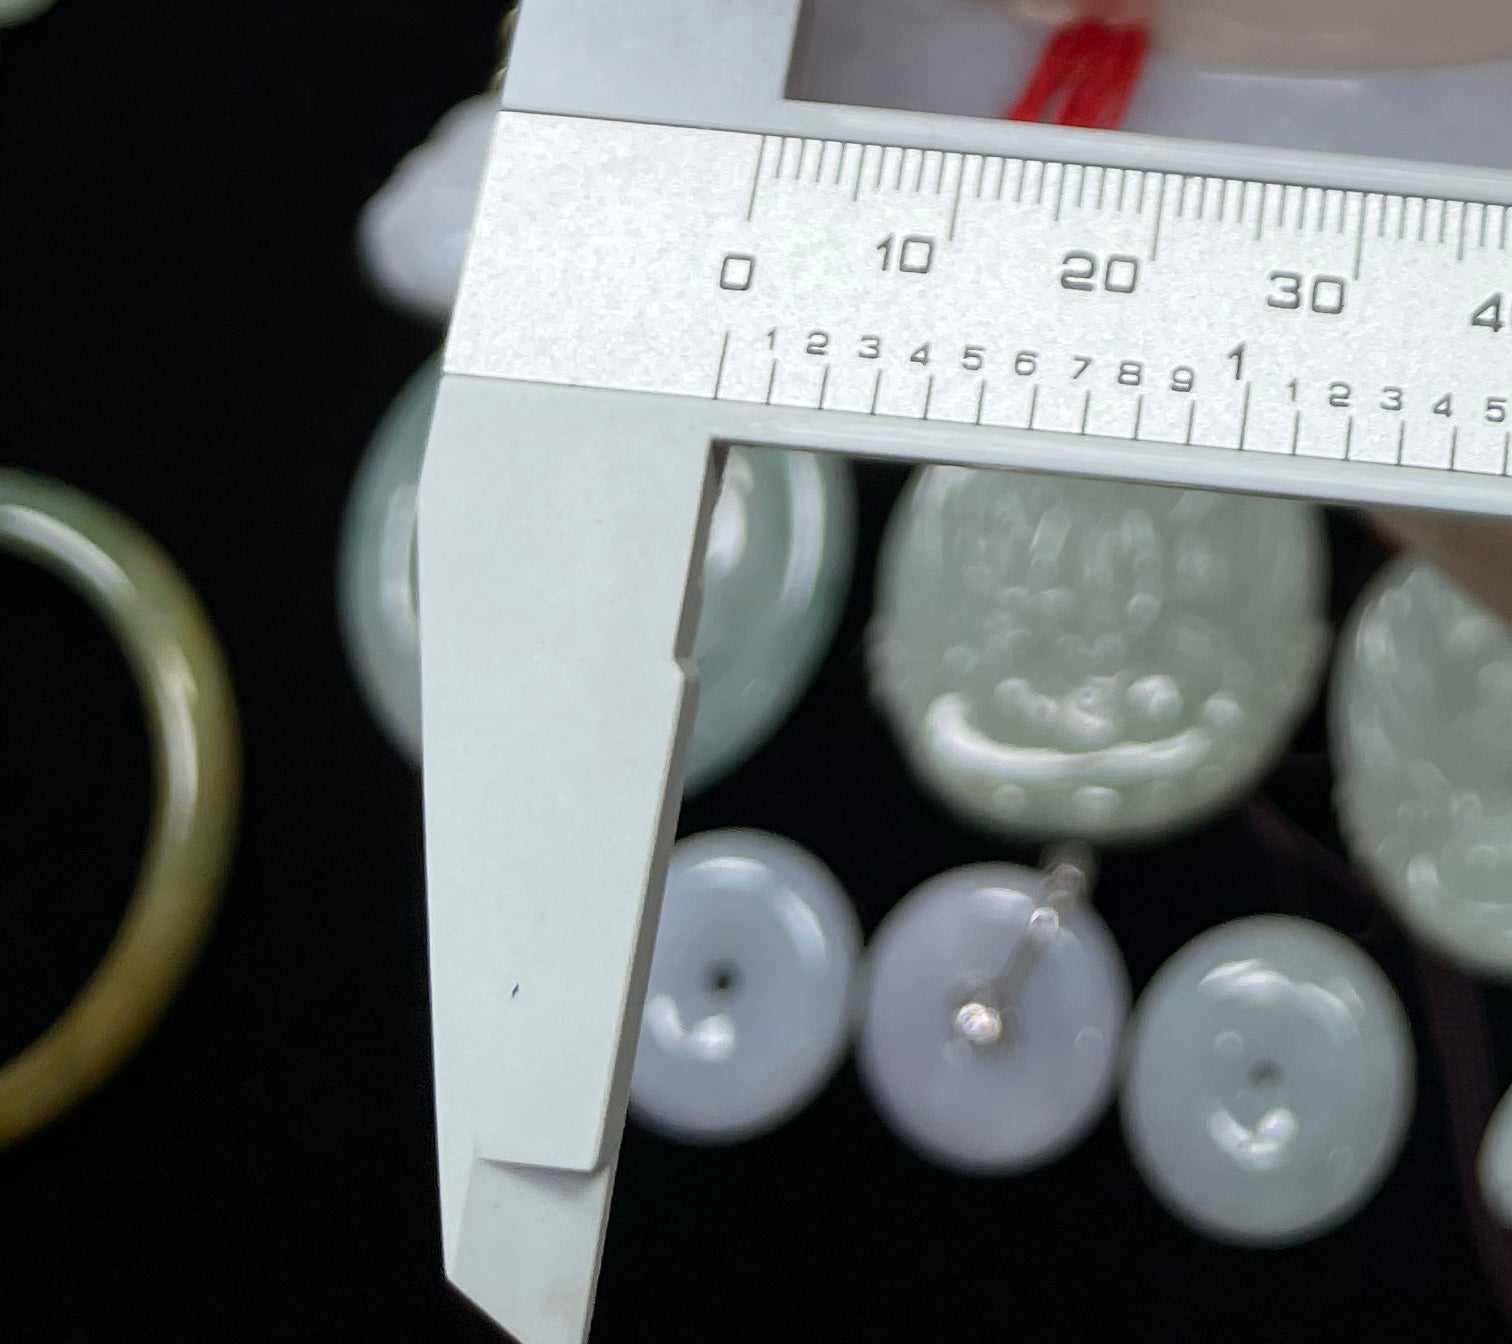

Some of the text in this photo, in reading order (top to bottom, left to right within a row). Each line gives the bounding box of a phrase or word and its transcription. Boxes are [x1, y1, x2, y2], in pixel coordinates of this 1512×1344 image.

[719, 253, 756, 291] 0
[876, 234, 935, 274] 10
[1060, 250, 1140, 294] 20
[1266, 270, 1346, 315] 30
[766, 326, 777, 350] 1
[806, 331, 830, 355] 2
[858, 335, 882, 360] 3
[909, 341, 930, 366] 4
[961, 345, 984, 371] 5
[1014, 350, 1038, 376] 6
[1071, 355, 1092, 379] 7
[1117, 360, 1143, 386] 8
[1170, 365, 1194, 392] 9
[1227, 340, 1247, 381] 1
[1287, 378, 1299, 402] 1
[1328, 381, 1352, 408] 2
[1380, 386, 1403, 411] 3
[1432, 393, 1453, 418] 4
[1486, 397, 1507, 423] 5
